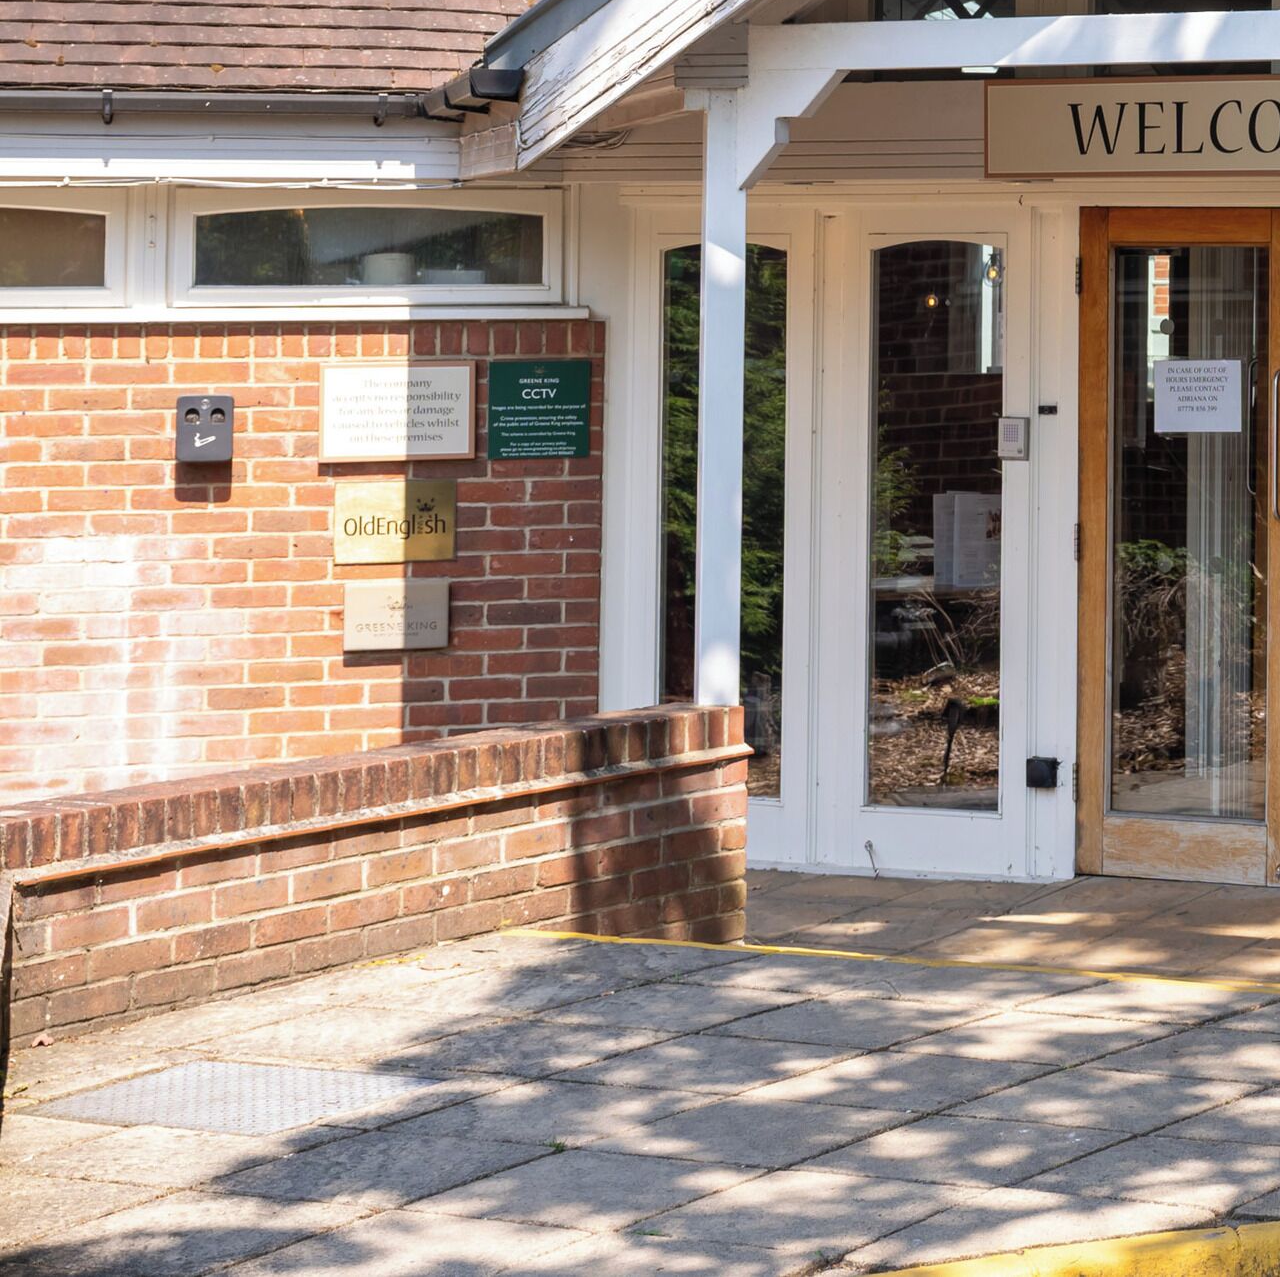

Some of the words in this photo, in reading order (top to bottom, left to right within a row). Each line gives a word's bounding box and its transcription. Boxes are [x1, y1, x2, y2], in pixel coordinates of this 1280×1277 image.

[361, 379, 380, 388] The
[384, 379, 433, 390] company
[331, 394, 372, 403] accepts
[374, 394, 388, 402] no
[390, 391, 462, 402] responsibility
[522, 388, 557, 399] CCTV
[338, 407, 354, 416] for
[356, 408, 374, 416] any
[377, 406, 398, 415] loss
[400, 407, 412, 415] or
[413, 405, 455, 416] damage
[332, 420, 369, 429] caused
[370, 420, 383, 429] to
[384, 419, 425, 428] vehicles
[427, 418, 459, 427] whilst
[365, 433, 394, 442] these
[396, 431, 444, 442] premises
[355, 622, 403, 633] GREENE
[407, 620, 438, 631] KING
